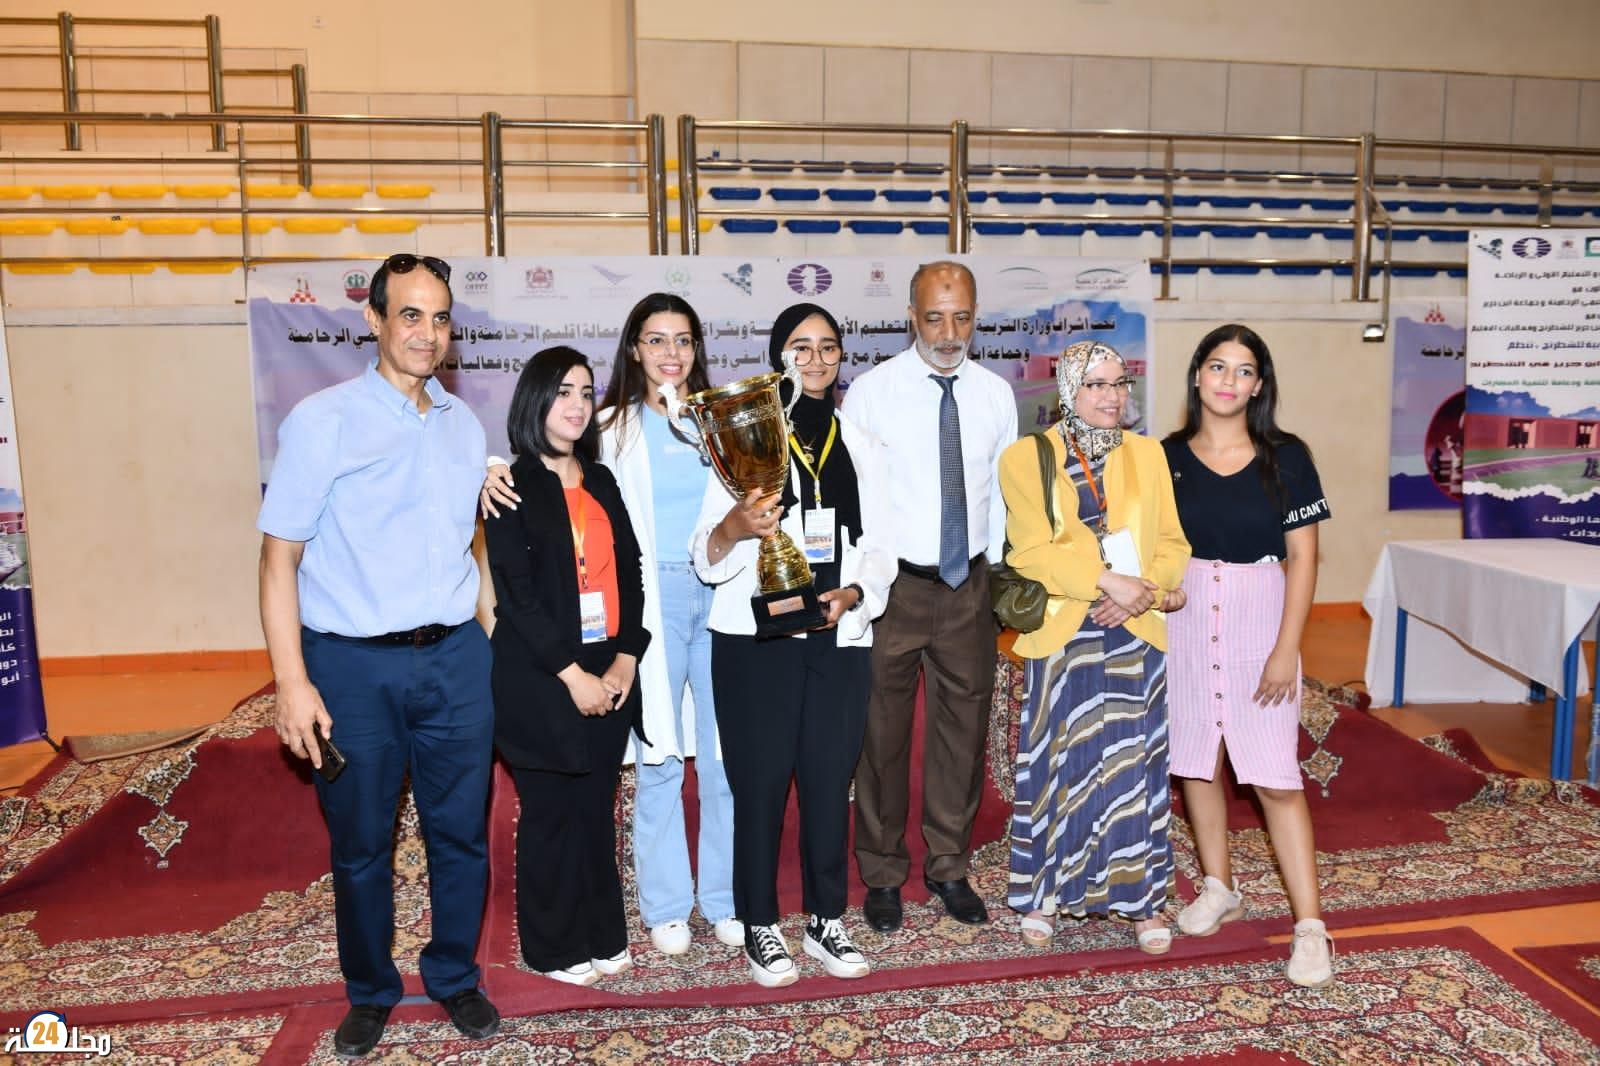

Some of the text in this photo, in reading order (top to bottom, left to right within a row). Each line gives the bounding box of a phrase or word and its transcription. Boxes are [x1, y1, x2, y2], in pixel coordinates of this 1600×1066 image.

[477, 323, 540, 344] الرحامنة
[839, 316, 858, 337] الأو
[976, 316, 1116, 336] تحت اشراف وزارة التربية
[287, 326, 351, 347] الرحامنة
[851, 351, 869, 366] مع
[1421, 344, 1464, 360] لرحامنة
[445, 354, 510, 374] وفعاليات
[1299, 498, 1328, 519] CAN'T
